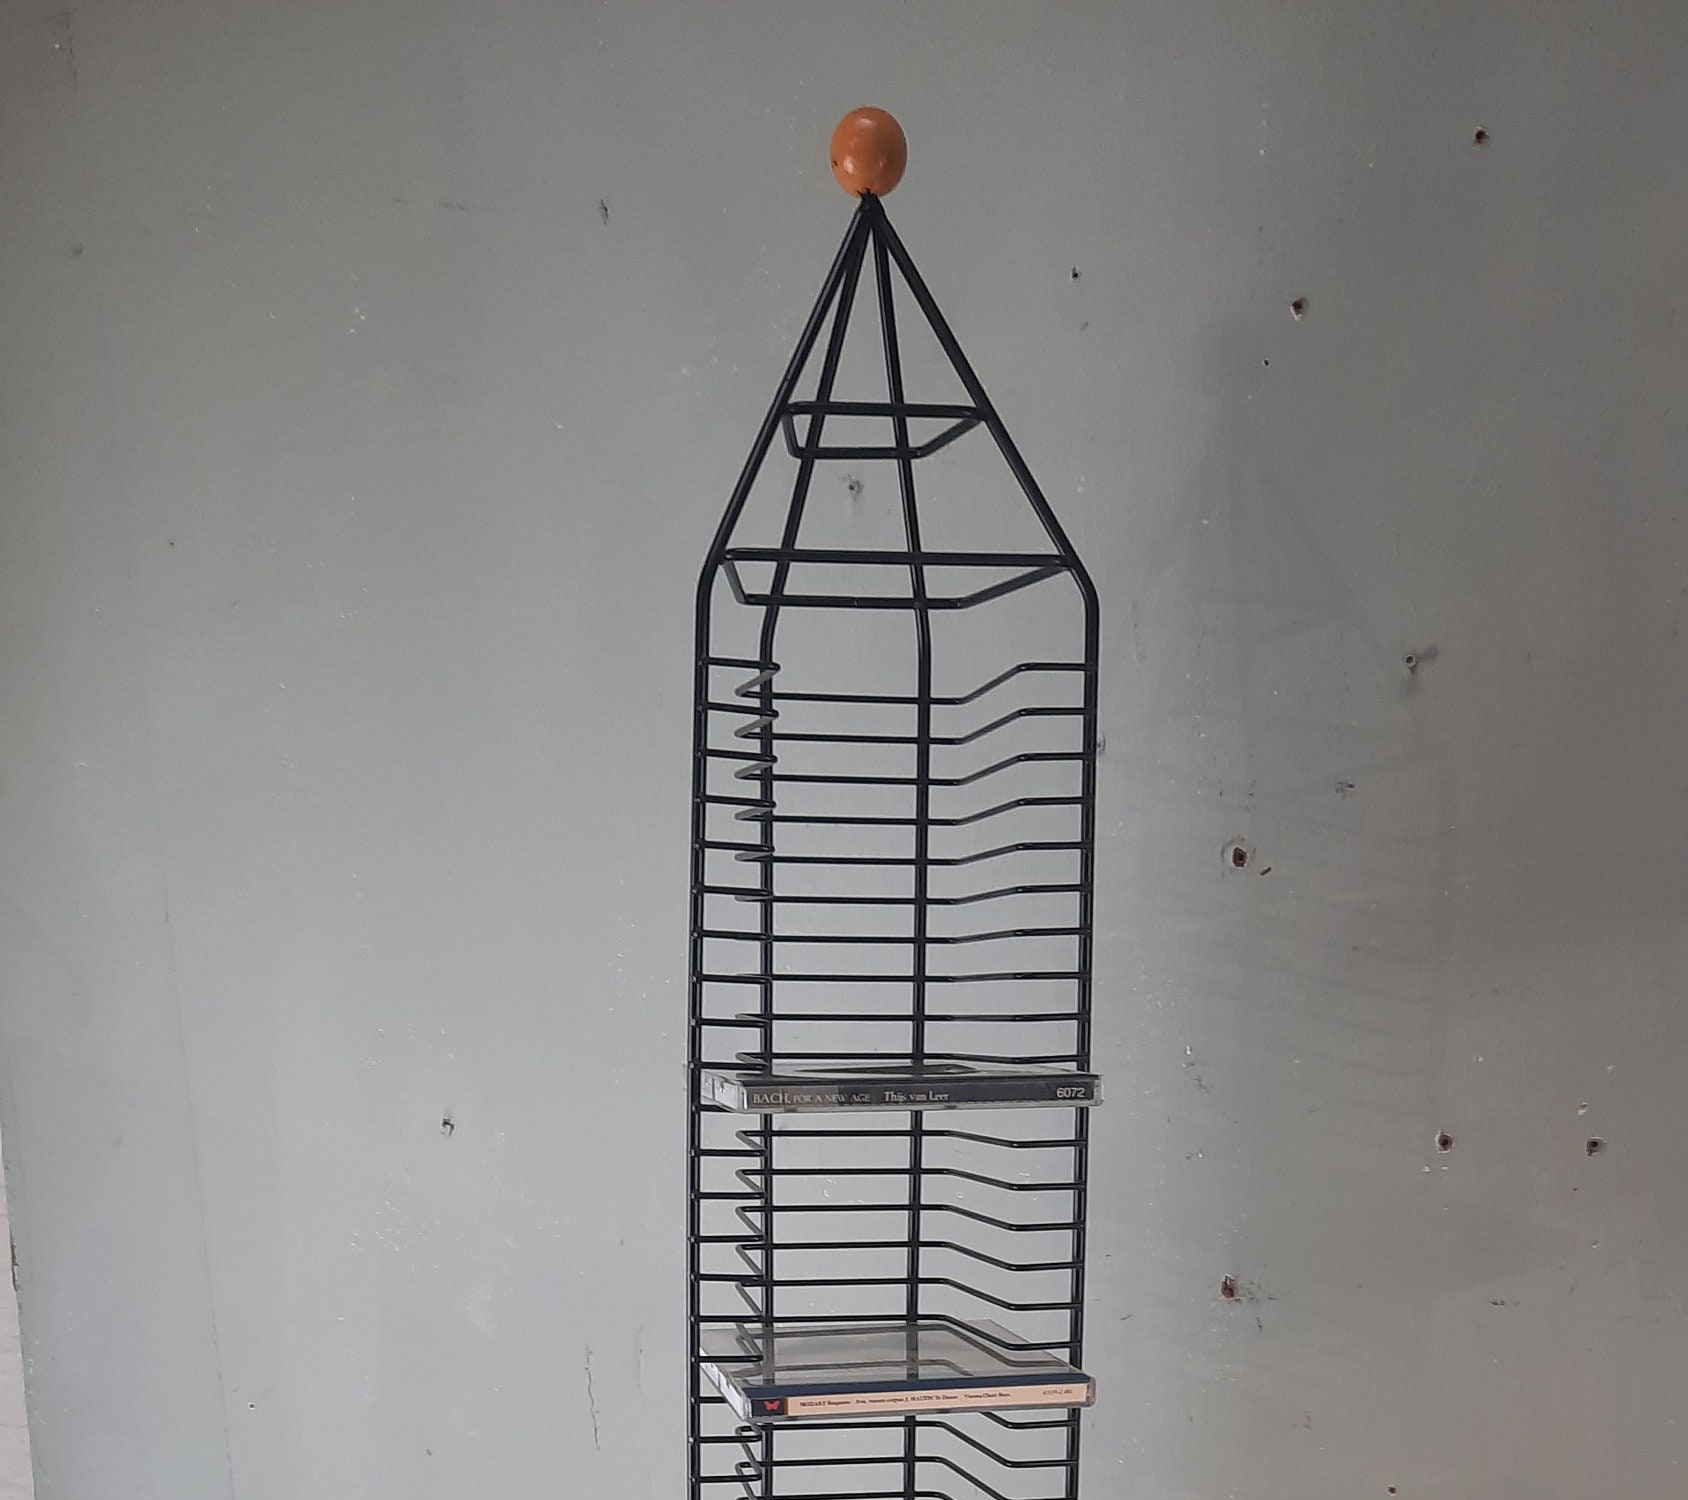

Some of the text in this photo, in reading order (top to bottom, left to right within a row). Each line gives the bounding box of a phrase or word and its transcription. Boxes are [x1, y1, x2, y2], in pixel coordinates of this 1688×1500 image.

[752, 1091, 791, 1105] BACH
[793, 1094, 812, 1104] FOR
[812, 1093, 823, 1103] A
[825, 1093, 848, 1103] NEW
[851, 1093, 871, 1103] AGE
[1056, 1086, 1086, 1099] 6072
